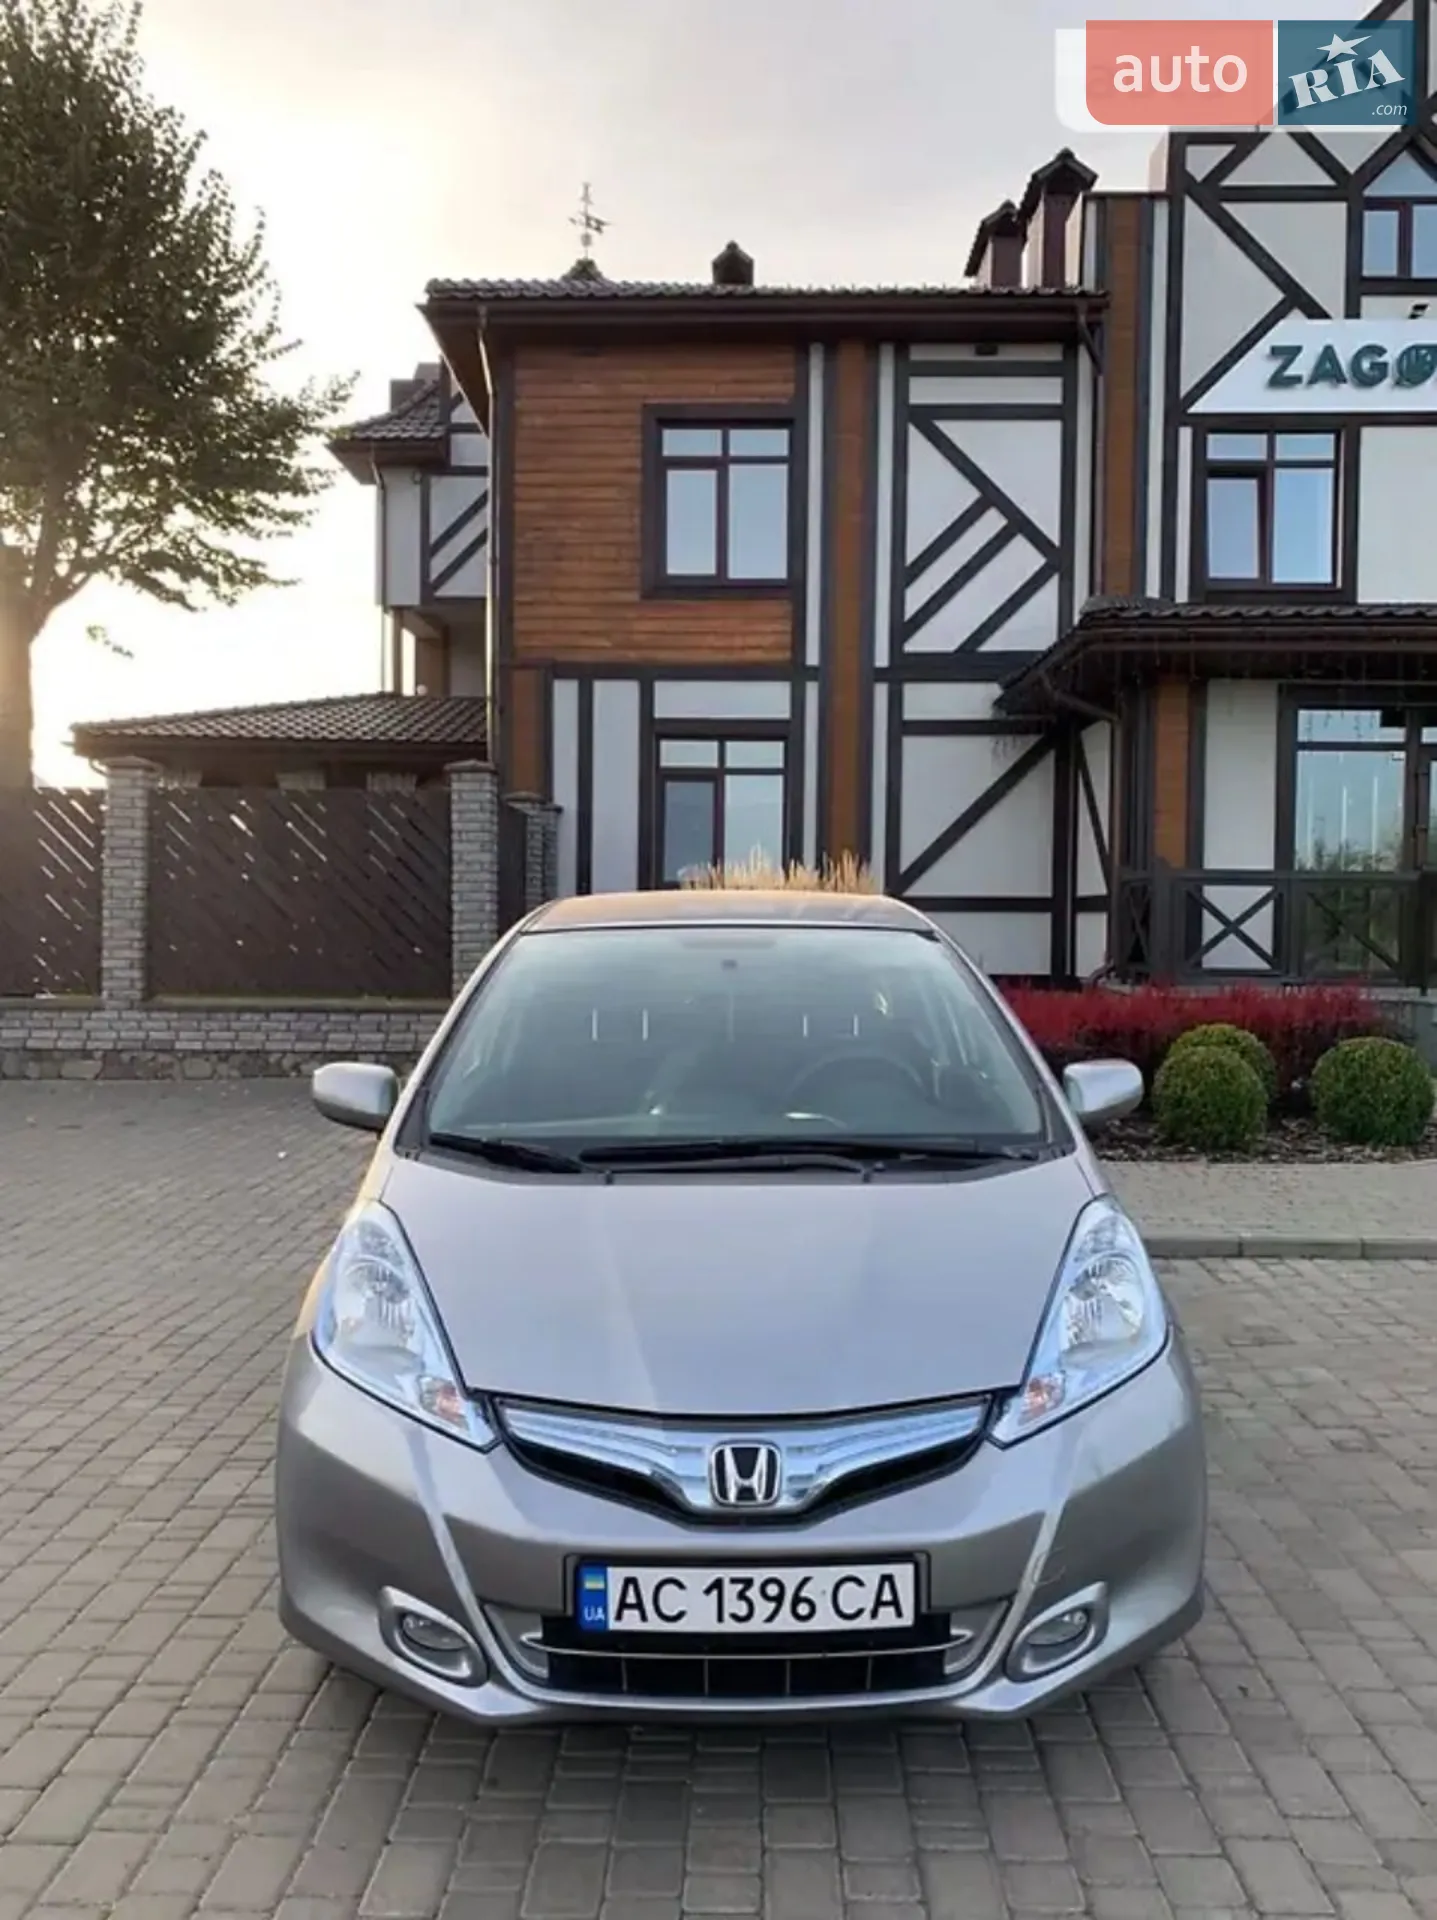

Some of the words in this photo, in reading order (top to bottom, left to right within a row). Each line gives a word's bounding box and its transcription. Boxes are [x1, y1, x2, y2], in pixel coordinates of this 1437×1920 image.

[584, 1605, 605, 1621] UA
[614, 1576, 688, 1624] AC
[702, 1576, 817, 1624] 1396
[831, 1573, 904, 1622] CA
